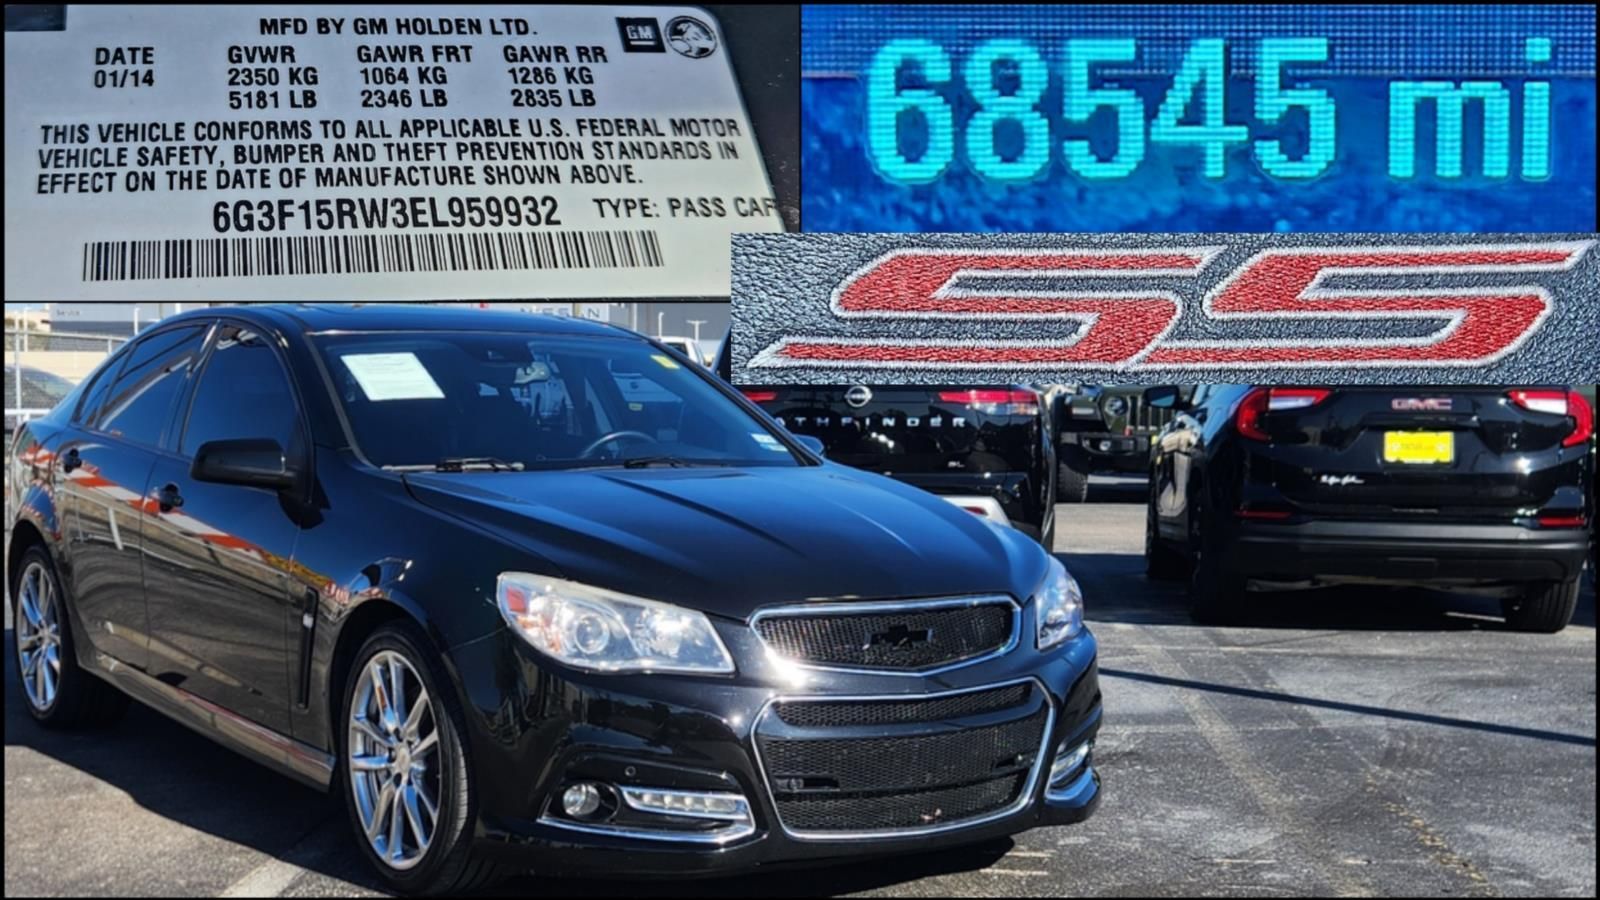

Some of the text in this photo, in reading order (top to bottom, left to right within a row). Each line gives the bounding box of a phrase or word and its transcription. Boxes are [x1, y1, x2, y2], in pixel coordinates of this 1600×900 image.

[260, 18, 537, 35] MFD BY GM HOLDEN LTD.
[95, 47, 154, 65] DATE
[228, 46, 295, 64] GVWR
[357, 45, 472, 63] GAWR FRT
[503, 45, 608, 63] GAWR RR
[94, 69, 154, 88] 01/14
[228, 67, 318, 86] 2350 KG
[360, 66, 447, 85] 1064 KG
[508, 67, 594, 84] 1286 KG
[229, 90, 317, 109] 5181 LB
[361, 89, 447, 107] 2346 LB
[512, 89, 596, 107] 2835 LB
[867, 37, 1552, 182] 68545 mi
[41, 118, 741, 144] THIS VEHICLE CONFORMS TO ALL APPLICABLE U.S. FEDERAL MOTOR
[39, 141, 738, 168] VEHICLE SAFETY, BUMPER AND THEFT PREVENTION STANDARDS IN
[37, 165, 643, 194] EFFECT ON THE DATE OF MANUFACTURE SHOWN ABOVE.
[213, 196, 561, 232] 6G3F15RW3EL959932
[593, 198, 660, 217] TYPE:
[668, 198, 727, 217] PASS
[748, 241, 1597, 372] SS
[1392, 398, 1453, 410] GMC
